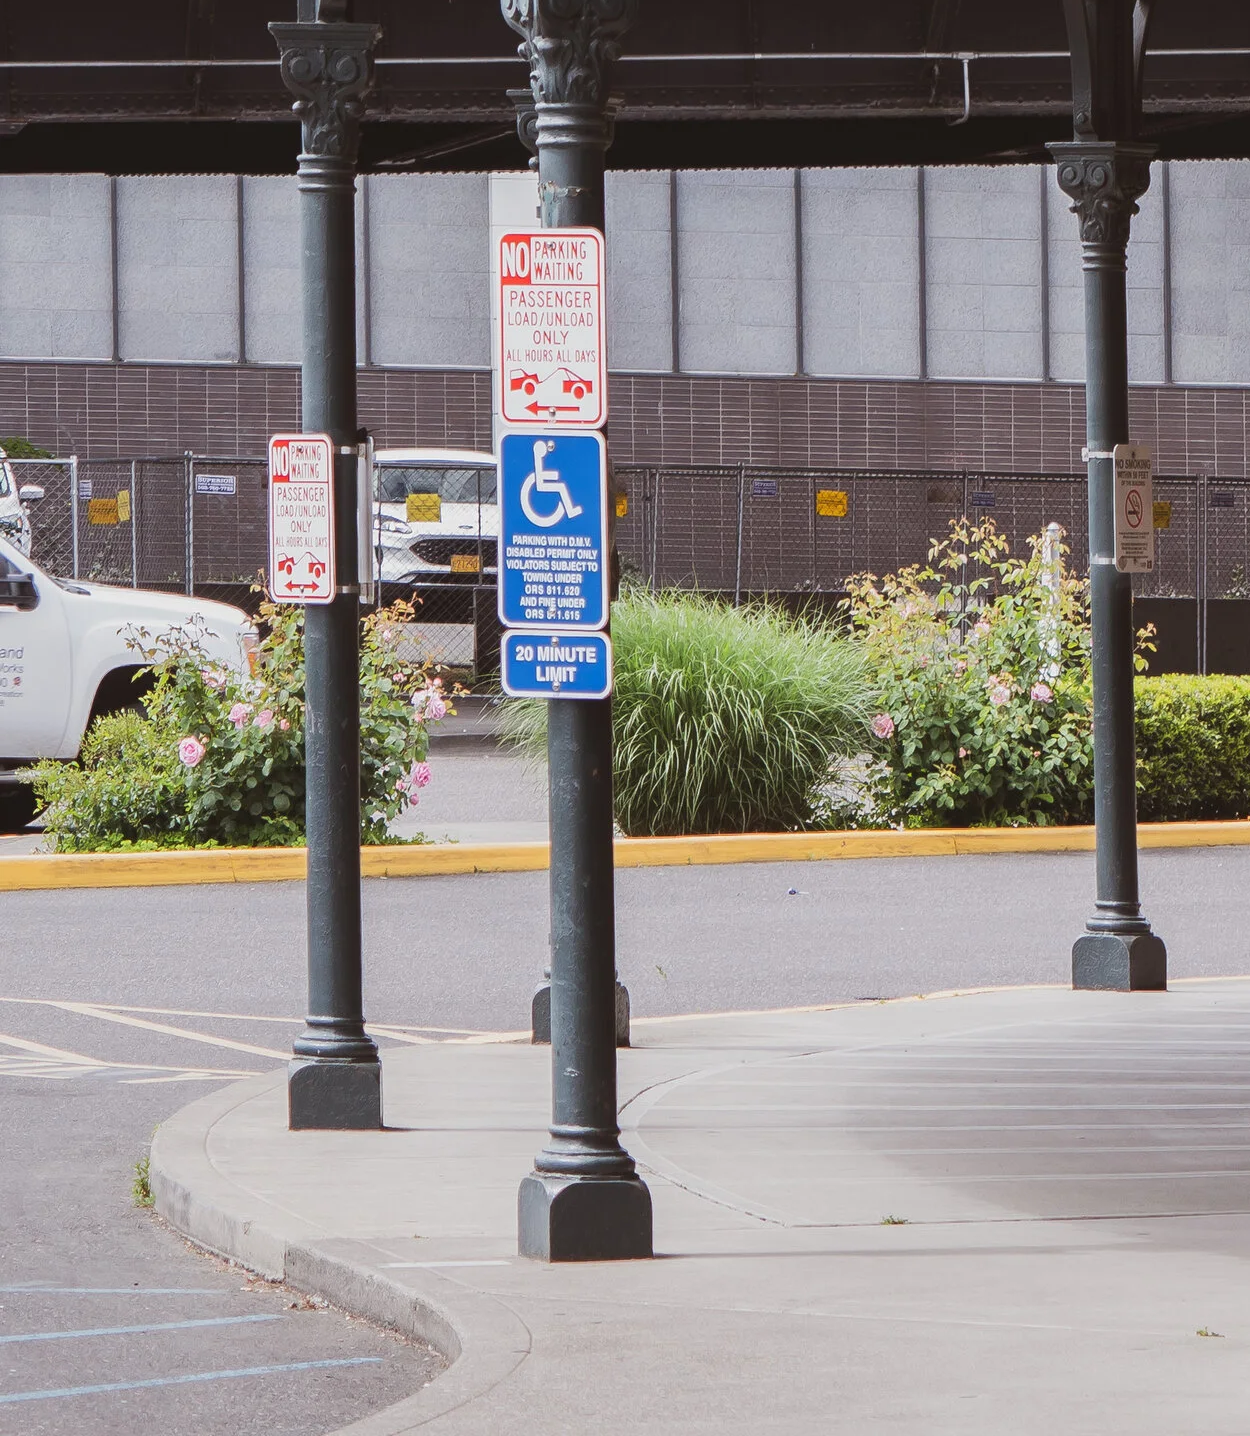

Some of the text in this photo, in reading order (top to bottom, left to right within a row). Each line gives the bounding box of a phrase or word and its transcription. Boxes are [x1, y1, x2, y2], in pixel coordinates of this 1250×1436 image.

[535, 241, 586, 259] PARKING
[502, 242, 530, 278] NO
[534, 262, 582, 280] WAITING
[510, 291, 591, 308] PASSENGER
[508, 312, 593, 326] LOAD/UNLOAD
[533, 330, 568, 344] ONLY
[507, 350, 595, 363] ALL HOURS ALL DAYS
[291, 446, 321, 460] PARKING
[273, 446, 288, 476] NO
[1116, 460, 1150, 469] NO SMOKING
[291, 463, 319, 478] WAITING
[278, 487, 324, 501] PASSENGER
[277, 505, 326, 517] LOAD/UNLOAD
[291, 521, 312, 532] ONLY
[276, 537, 327, 547] ALL HOURS ALL DAYS
[513, 535, 591, 547] PARKING WITH D.M.V.
[507, 547, 597, 559] DISABLED PERMIT ONLY
[506, 560, 598, 572] VIOLATORS SUBJECT TO
[522, 572, 582, 583] TOWING UNDER
[525, 585, 580, 596] ORS 811.620
[520, 597, 585, 608] AND FINE UNDER
[525, 609, 544, 619] ORS
[515, 646, 596, 663] 20 MINUTE
[536, 666, 577, 682] LIMIT
